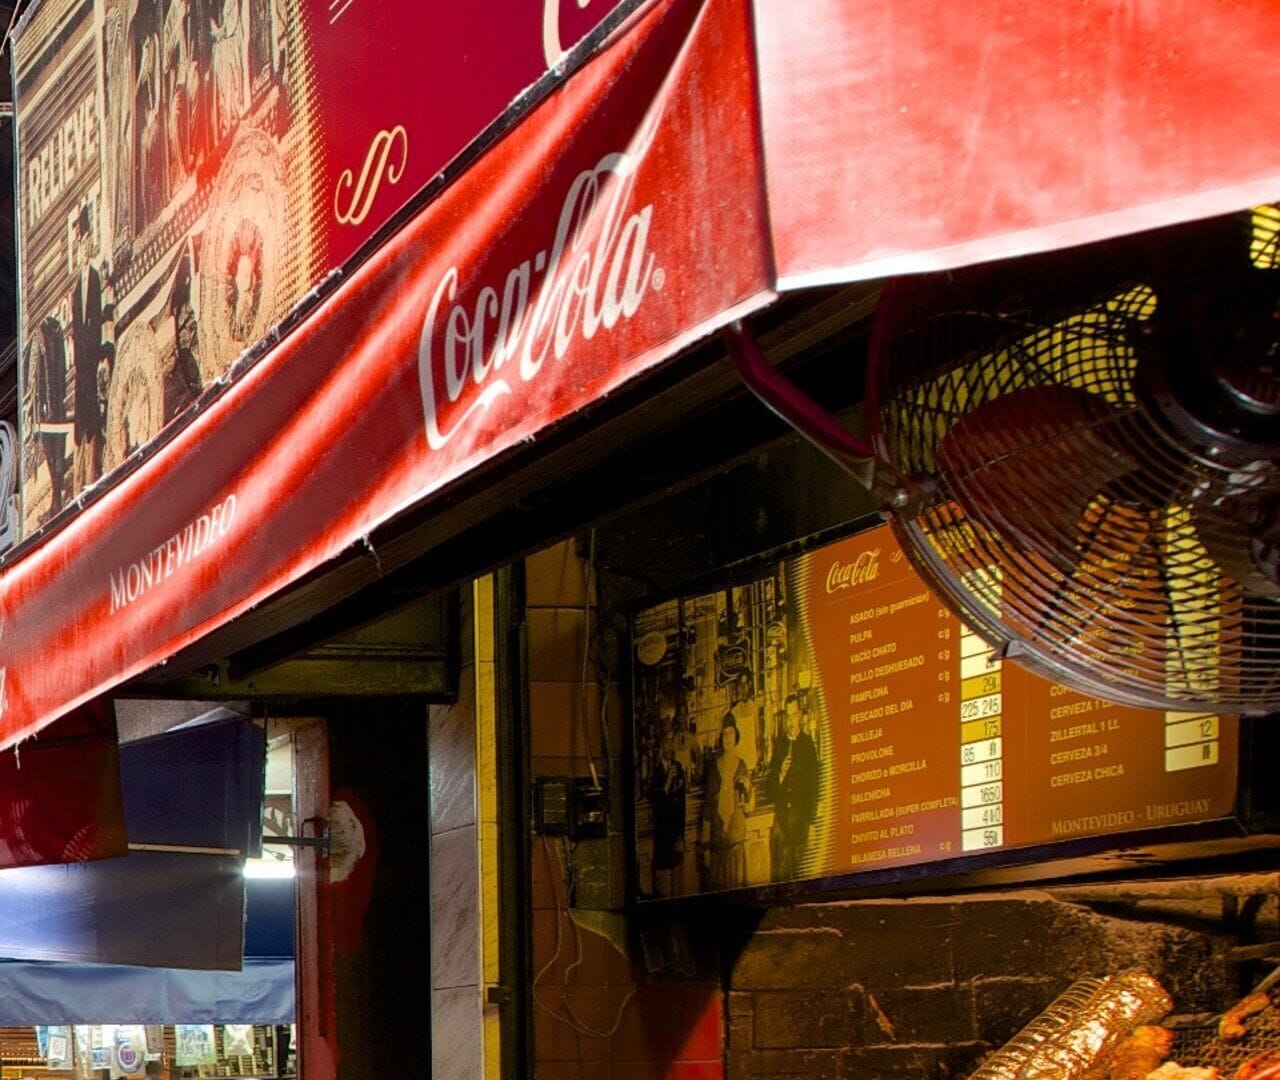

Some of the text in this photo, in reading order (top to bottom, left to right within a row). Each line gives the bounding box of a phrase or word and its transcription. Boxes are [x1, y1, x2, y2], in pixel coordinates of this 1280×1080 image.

[418, 150, 654, 451] Coca-Cola
[109, 494, 238, 616] MONTEVIDEO
[826, 547, 881, 594] Coca-Cola
[849, 609, 875, 625] ASADO
[849, 629, 873, 645] PULPA
[872, 642, 897, 659] CHATO
[849, 668, 874, 684] POLLO
[875, 655, 925, 678] DESHUESADO
[849, 685, 889, 704] PAMPLONA
[850, 706, 885, 724] PESCADO
[885, 703, 900, 716] DEL
[1049, 700, 1092, 719] CERVEZA
[850, 728, 883, 744] MOLLEJA
[1049, 722, 1099, 742] ZILLERTAL
[850, 745, 895, 764] PROVOLONE
[1049, 746, 1093, 765] CERVEZA
[851, 768, 882, 785] CHORIZO
[889, 759, 928, 776] MORCILLA
[1049, 764, 1125, 788] CERVEZA CHICA
[850, 787, 891, 805] SALCHICHA
[851, 805, 895, 824] PARRILLADA
[1051, 810, 1134, 836] MONTEVIDEO
[1146, 798, 1211, 820] URUGUAY
[851, 823, 915, 845] CHIVITO AL PLATO
[851, 848, 887, 865] MILANESA
[887, 843, 922, 860] RELLENA
